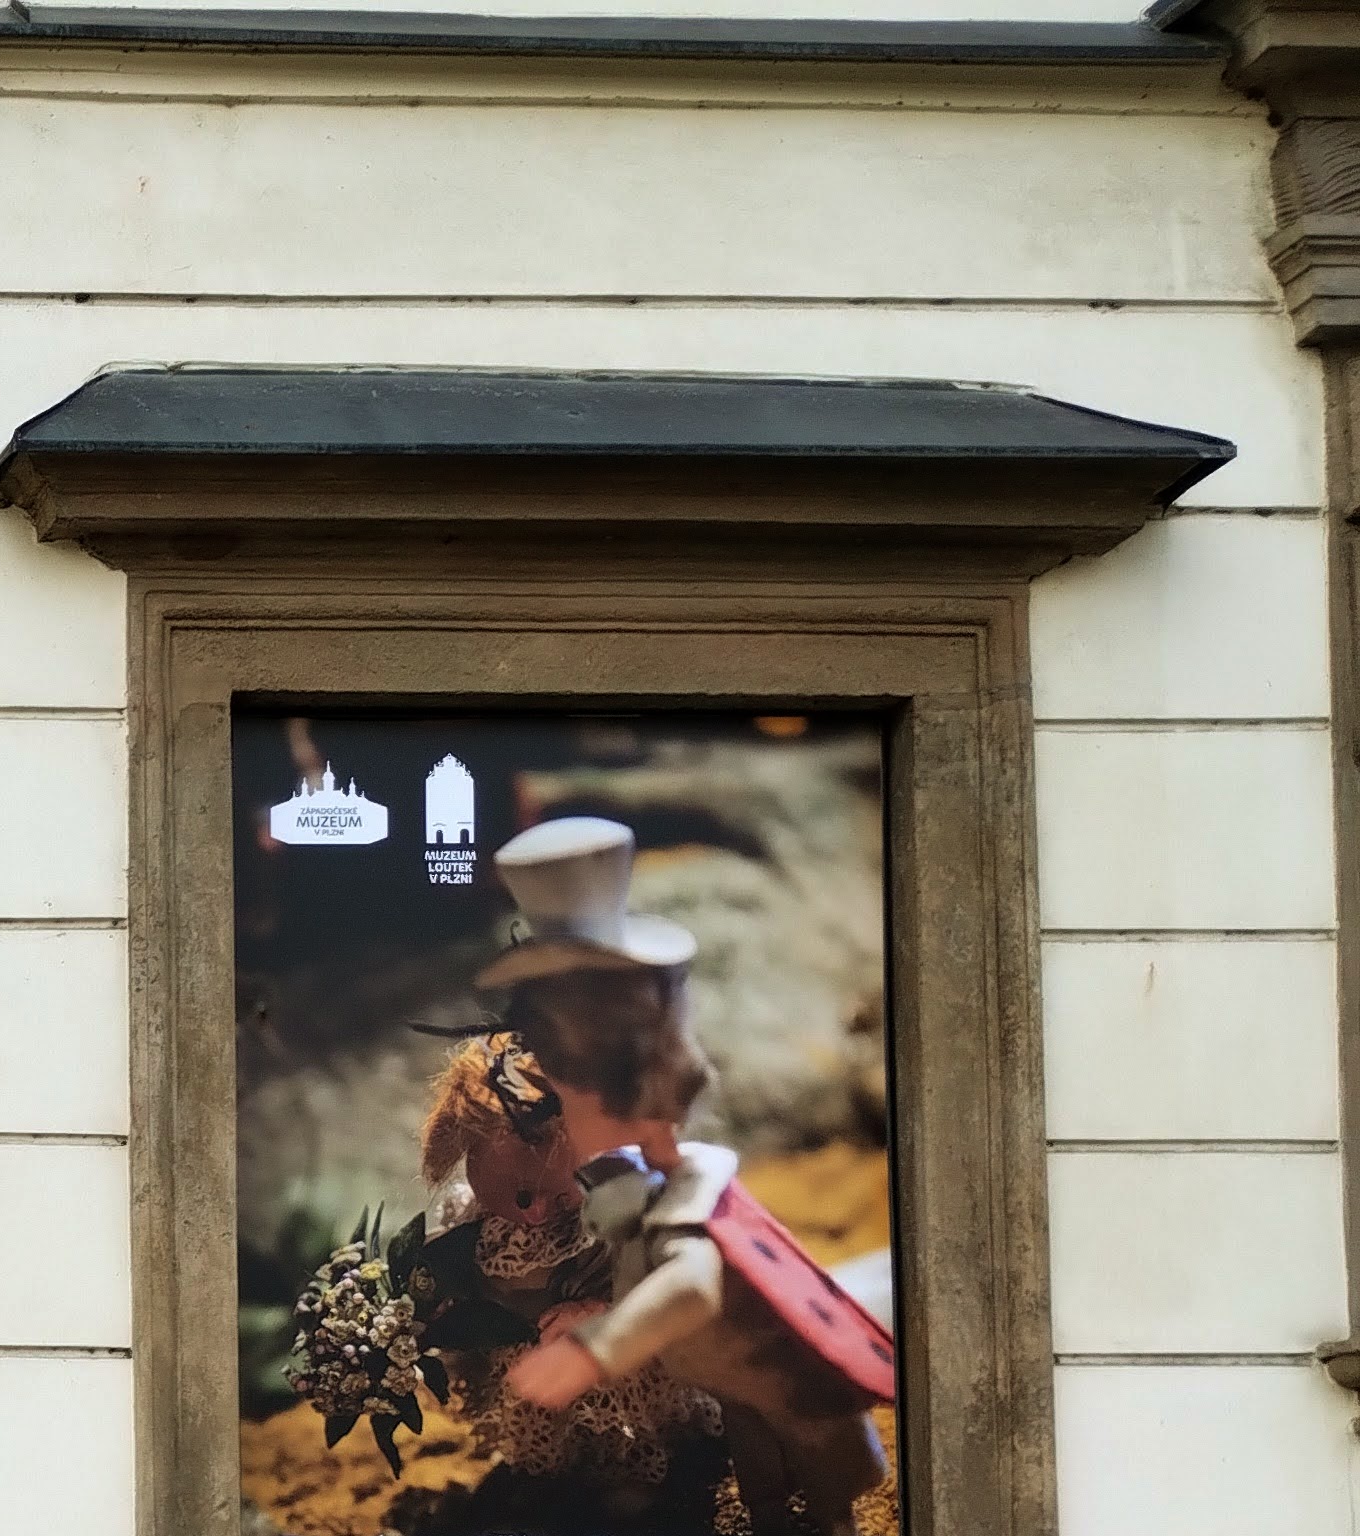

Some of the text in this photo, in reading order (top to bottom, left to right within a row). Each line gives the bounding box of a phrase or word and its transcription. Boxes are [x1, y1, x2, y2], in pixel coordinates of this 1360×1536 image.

[300, 806, 358, 815] ZÁPADOČESKÉ
[296, 816, 362, 827] MUZEUM
[424, 850, 477, 860] MUZEUM
[428, 862, 473, 872] LOUTEK
[429, 874, 472, 883] V PLZNI
